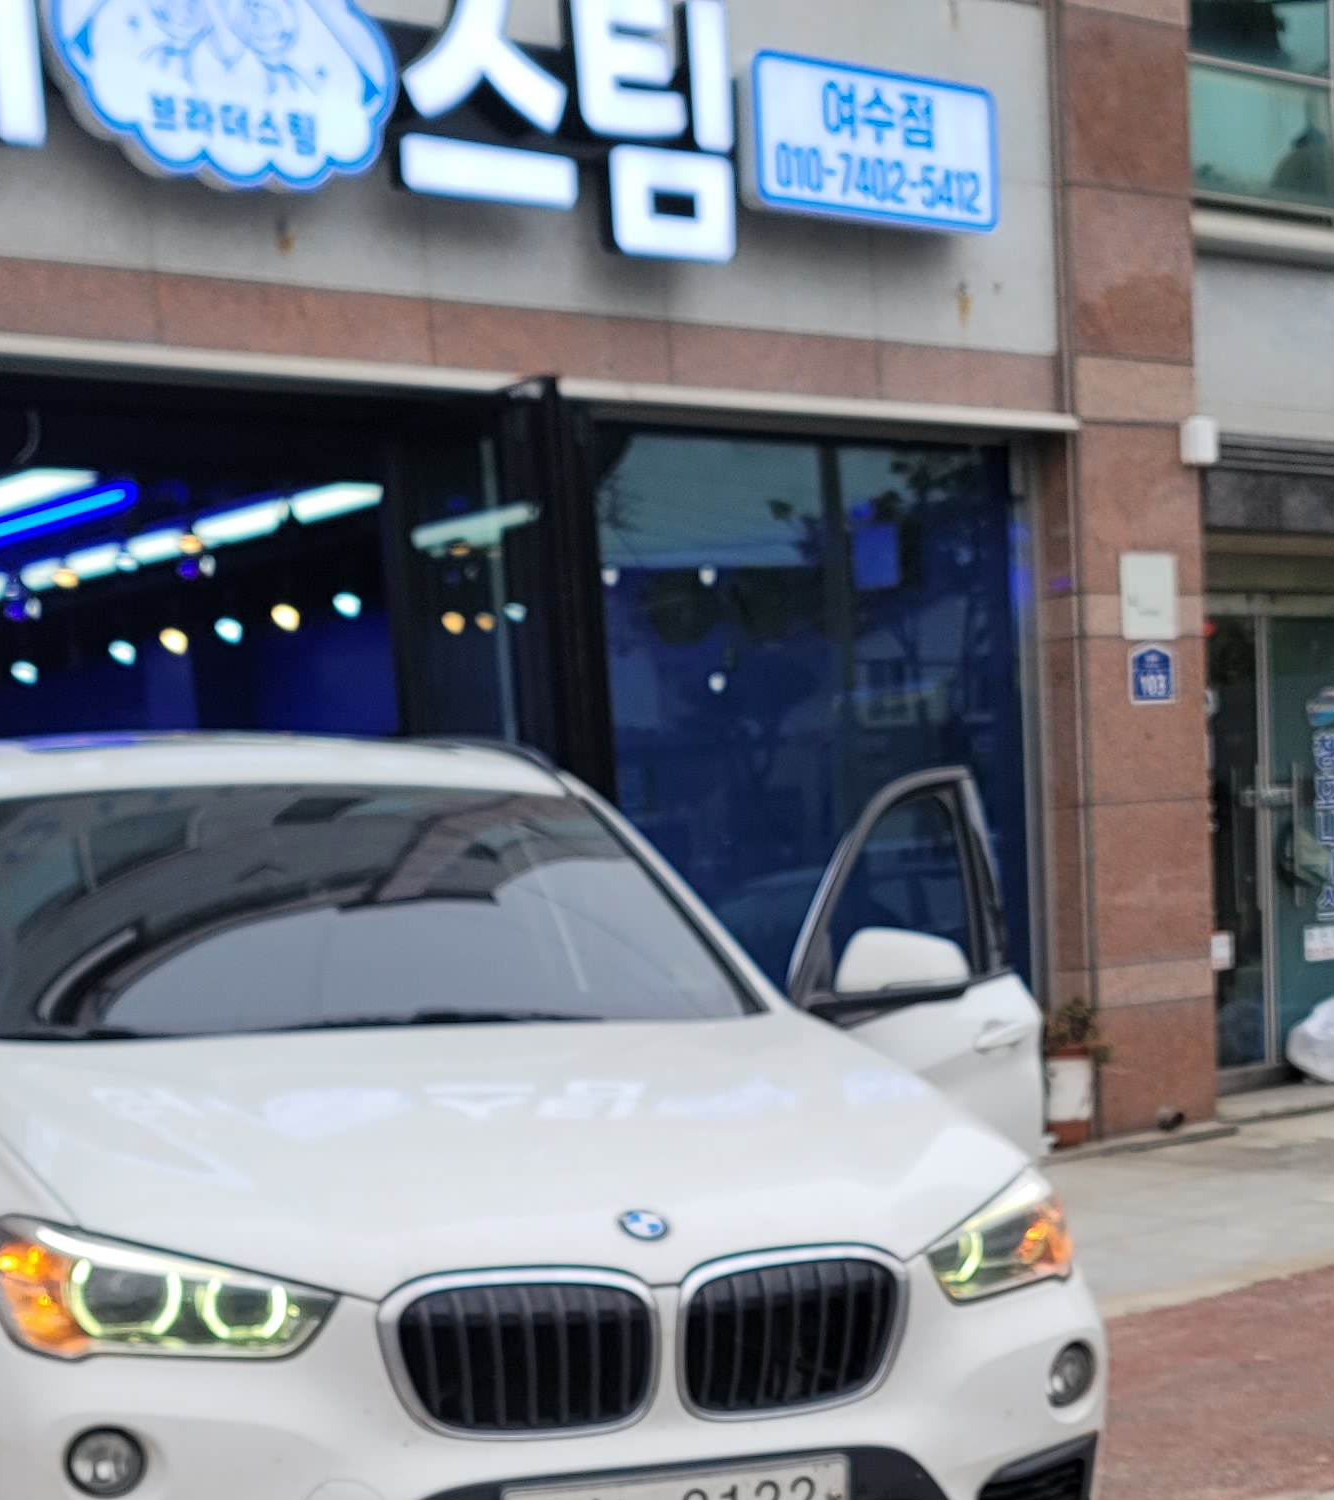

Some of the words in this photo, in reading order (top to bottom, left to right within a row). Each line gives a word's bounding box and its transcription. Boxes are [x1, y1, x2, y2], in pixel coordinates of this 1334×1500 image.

[151, 94, 316, 156] 브라더스팀
[822, 79, 934, 151] 여수점
[775, 142, 982, 216] 010-7402-5412
